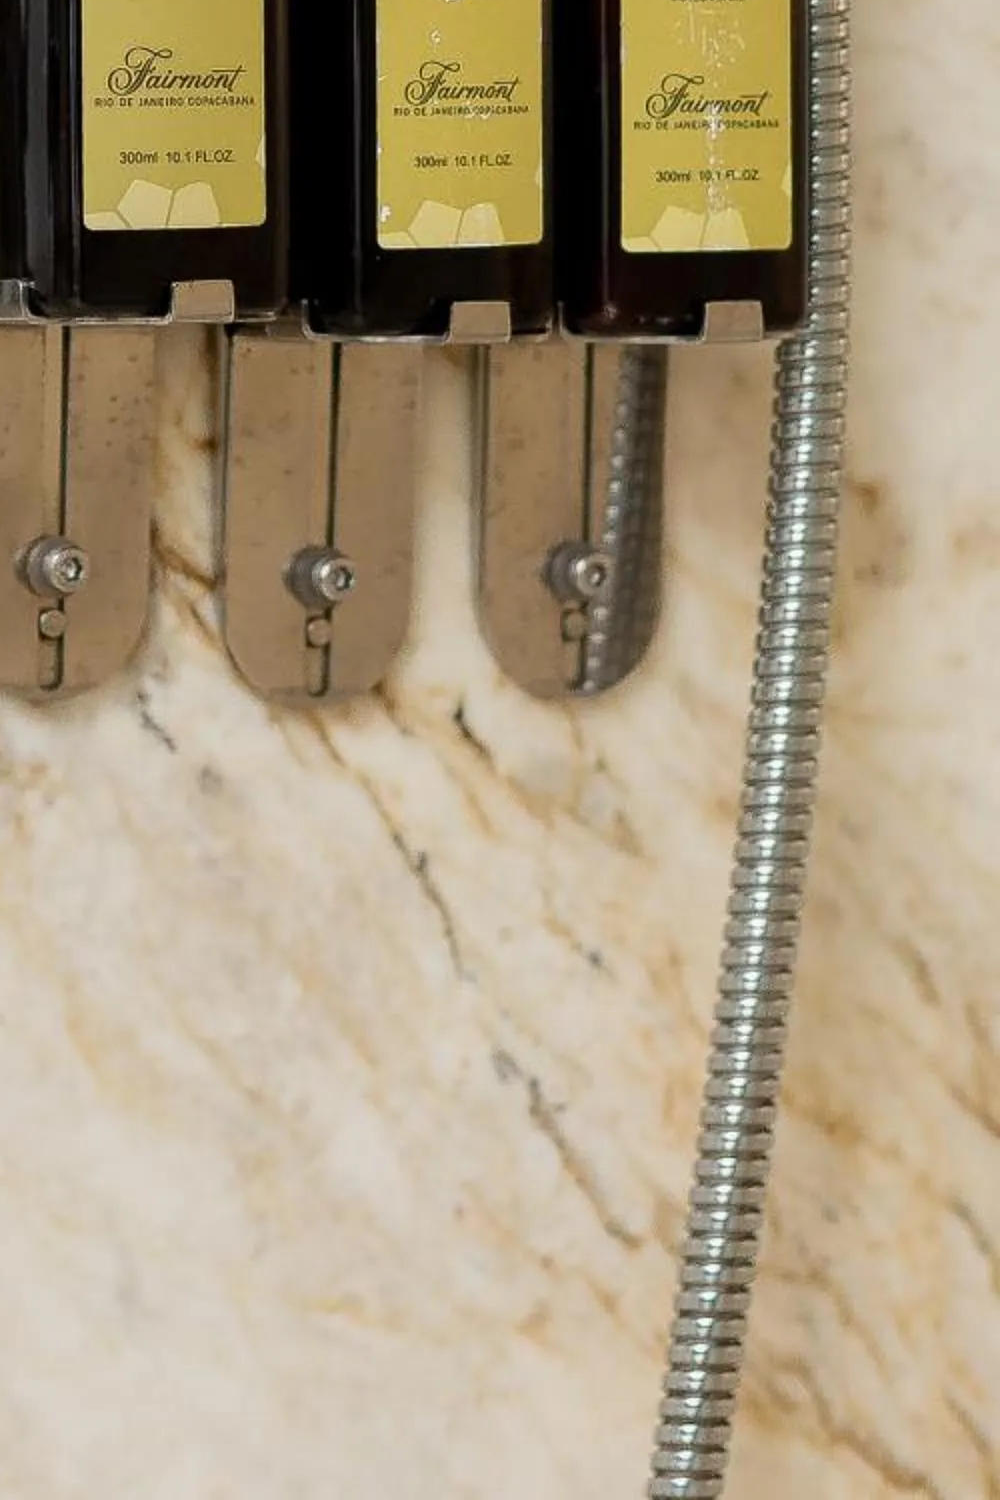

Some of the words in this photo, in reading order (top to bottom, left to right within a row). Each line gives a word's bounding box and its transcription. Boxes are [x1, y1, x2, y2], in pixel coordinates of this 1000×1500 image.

[107, 46, 247, 96] Fairmont
[404, 60, 520, 106] Fairmont
[95, 97, 114, 108] RIO
[119, 97, 132, 108] DE
[138, 96, 184, 107] JANEIRO
[188, 95, 255, 107] COPACABANA
[645, 73, 771, 119] Fairmont
[394, 105, 410, 117] RIO
[414, 106, 427, 117] DE
[634, 120, 650, 130] RIO
[656, 120, 668, 130] DE
[119, 151, 159, 164] 300ml
[165, 151, 191, 164] 10.1
[414, 157, 448, 168] 300ml
[455, 156, 477, 167] 10.1
[656, 171, 691, 183] 300ml
